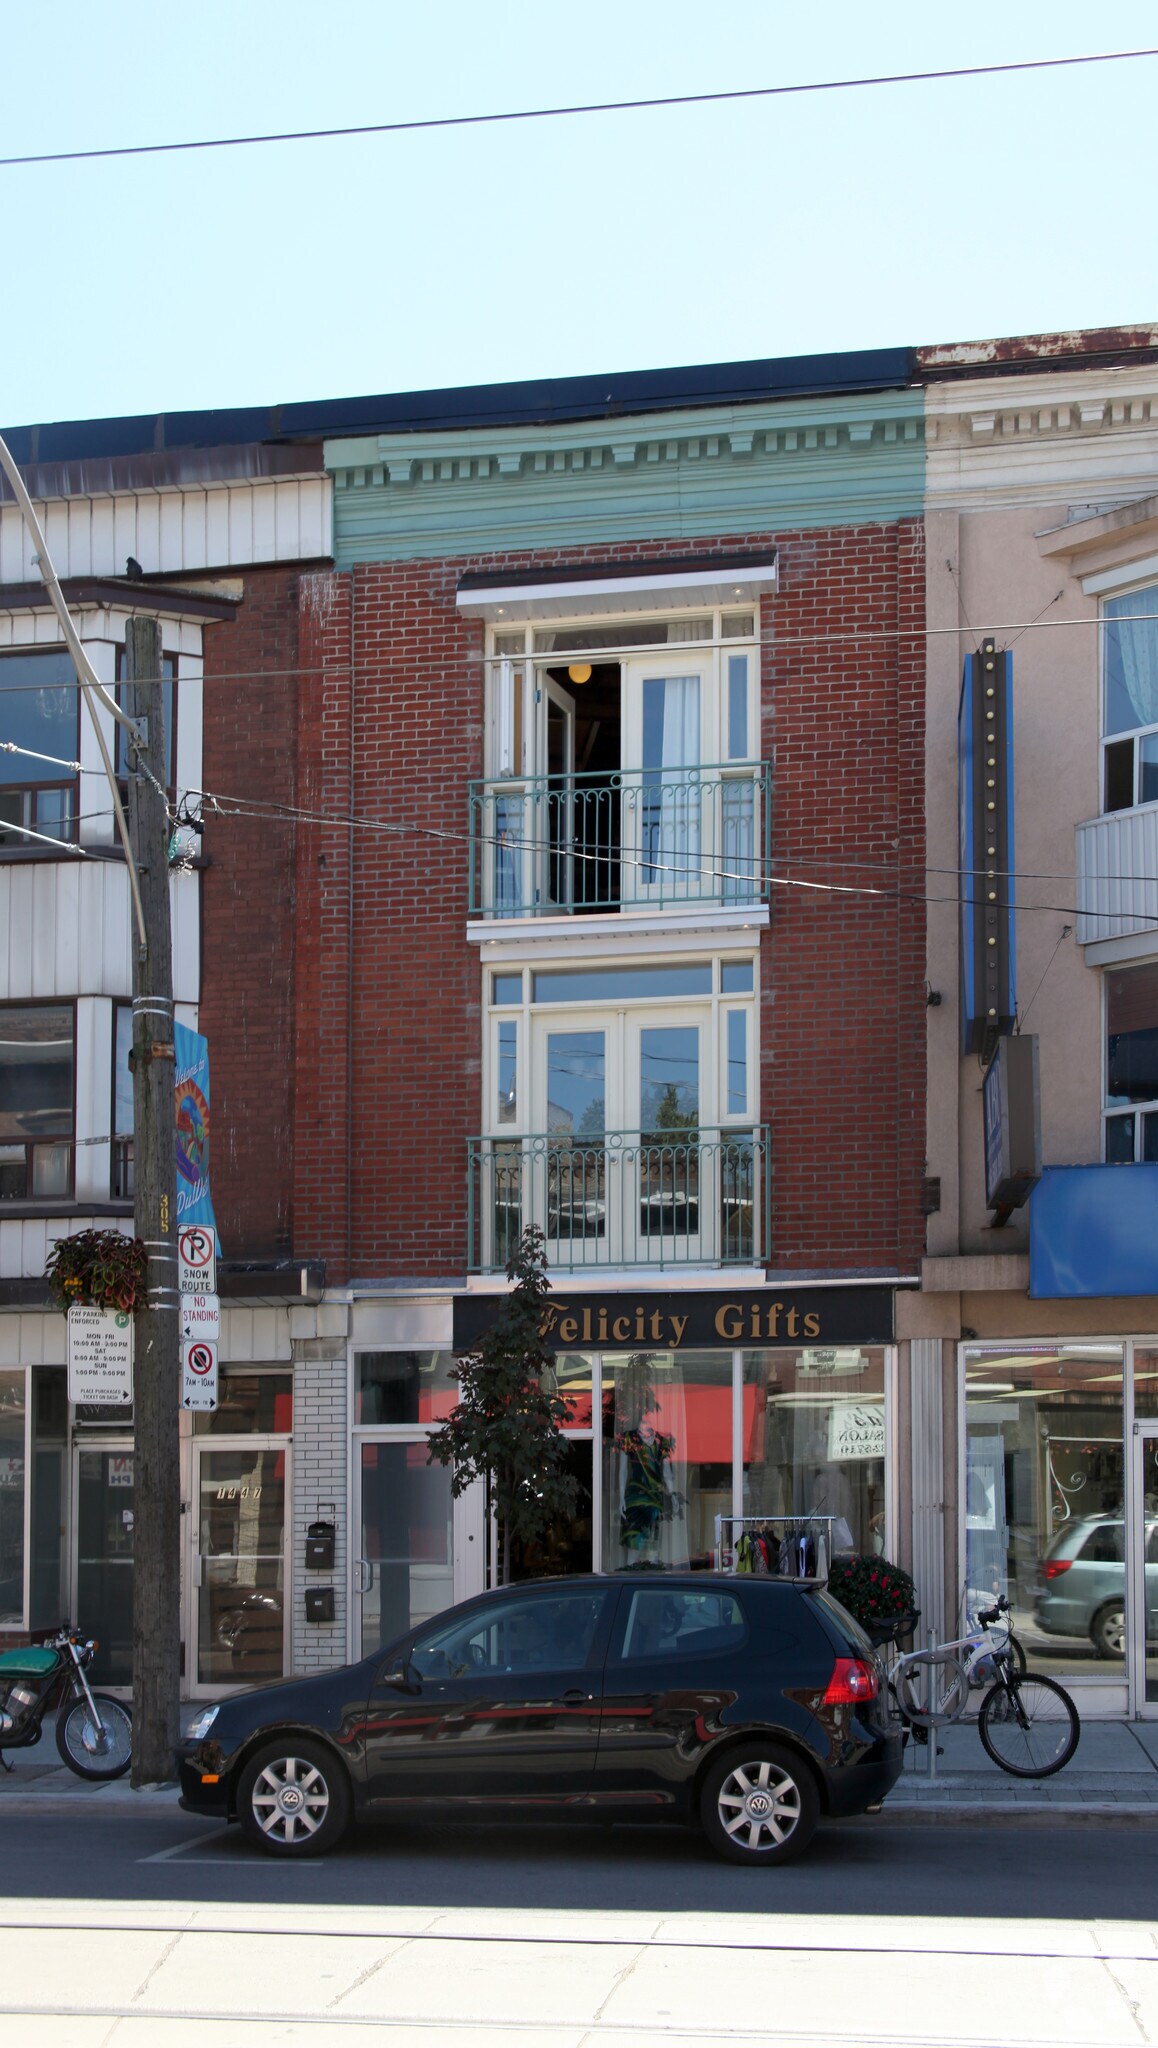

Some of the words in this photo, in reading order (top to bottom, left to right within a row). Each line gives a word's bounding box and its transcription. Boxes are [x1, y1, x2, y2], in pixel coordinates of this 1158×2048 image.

[160, 1194, 169, 1232] 305
[183, 1270, 209, 1279] SNOW
[182, 1281, 211, 1291] ROUTE
[193, 1296, 206, 1307] NO
[183, 1310, 219, 1321] STANDING
[539, 1302, 688, 1347] Felicity
[715, 1303, 821, 1339] Gifts
[185, 1377, 196, 1386] 7AM
[201, 1377, 215, 1387] 10AM
[218, 1487, 262, 1499] 1447
